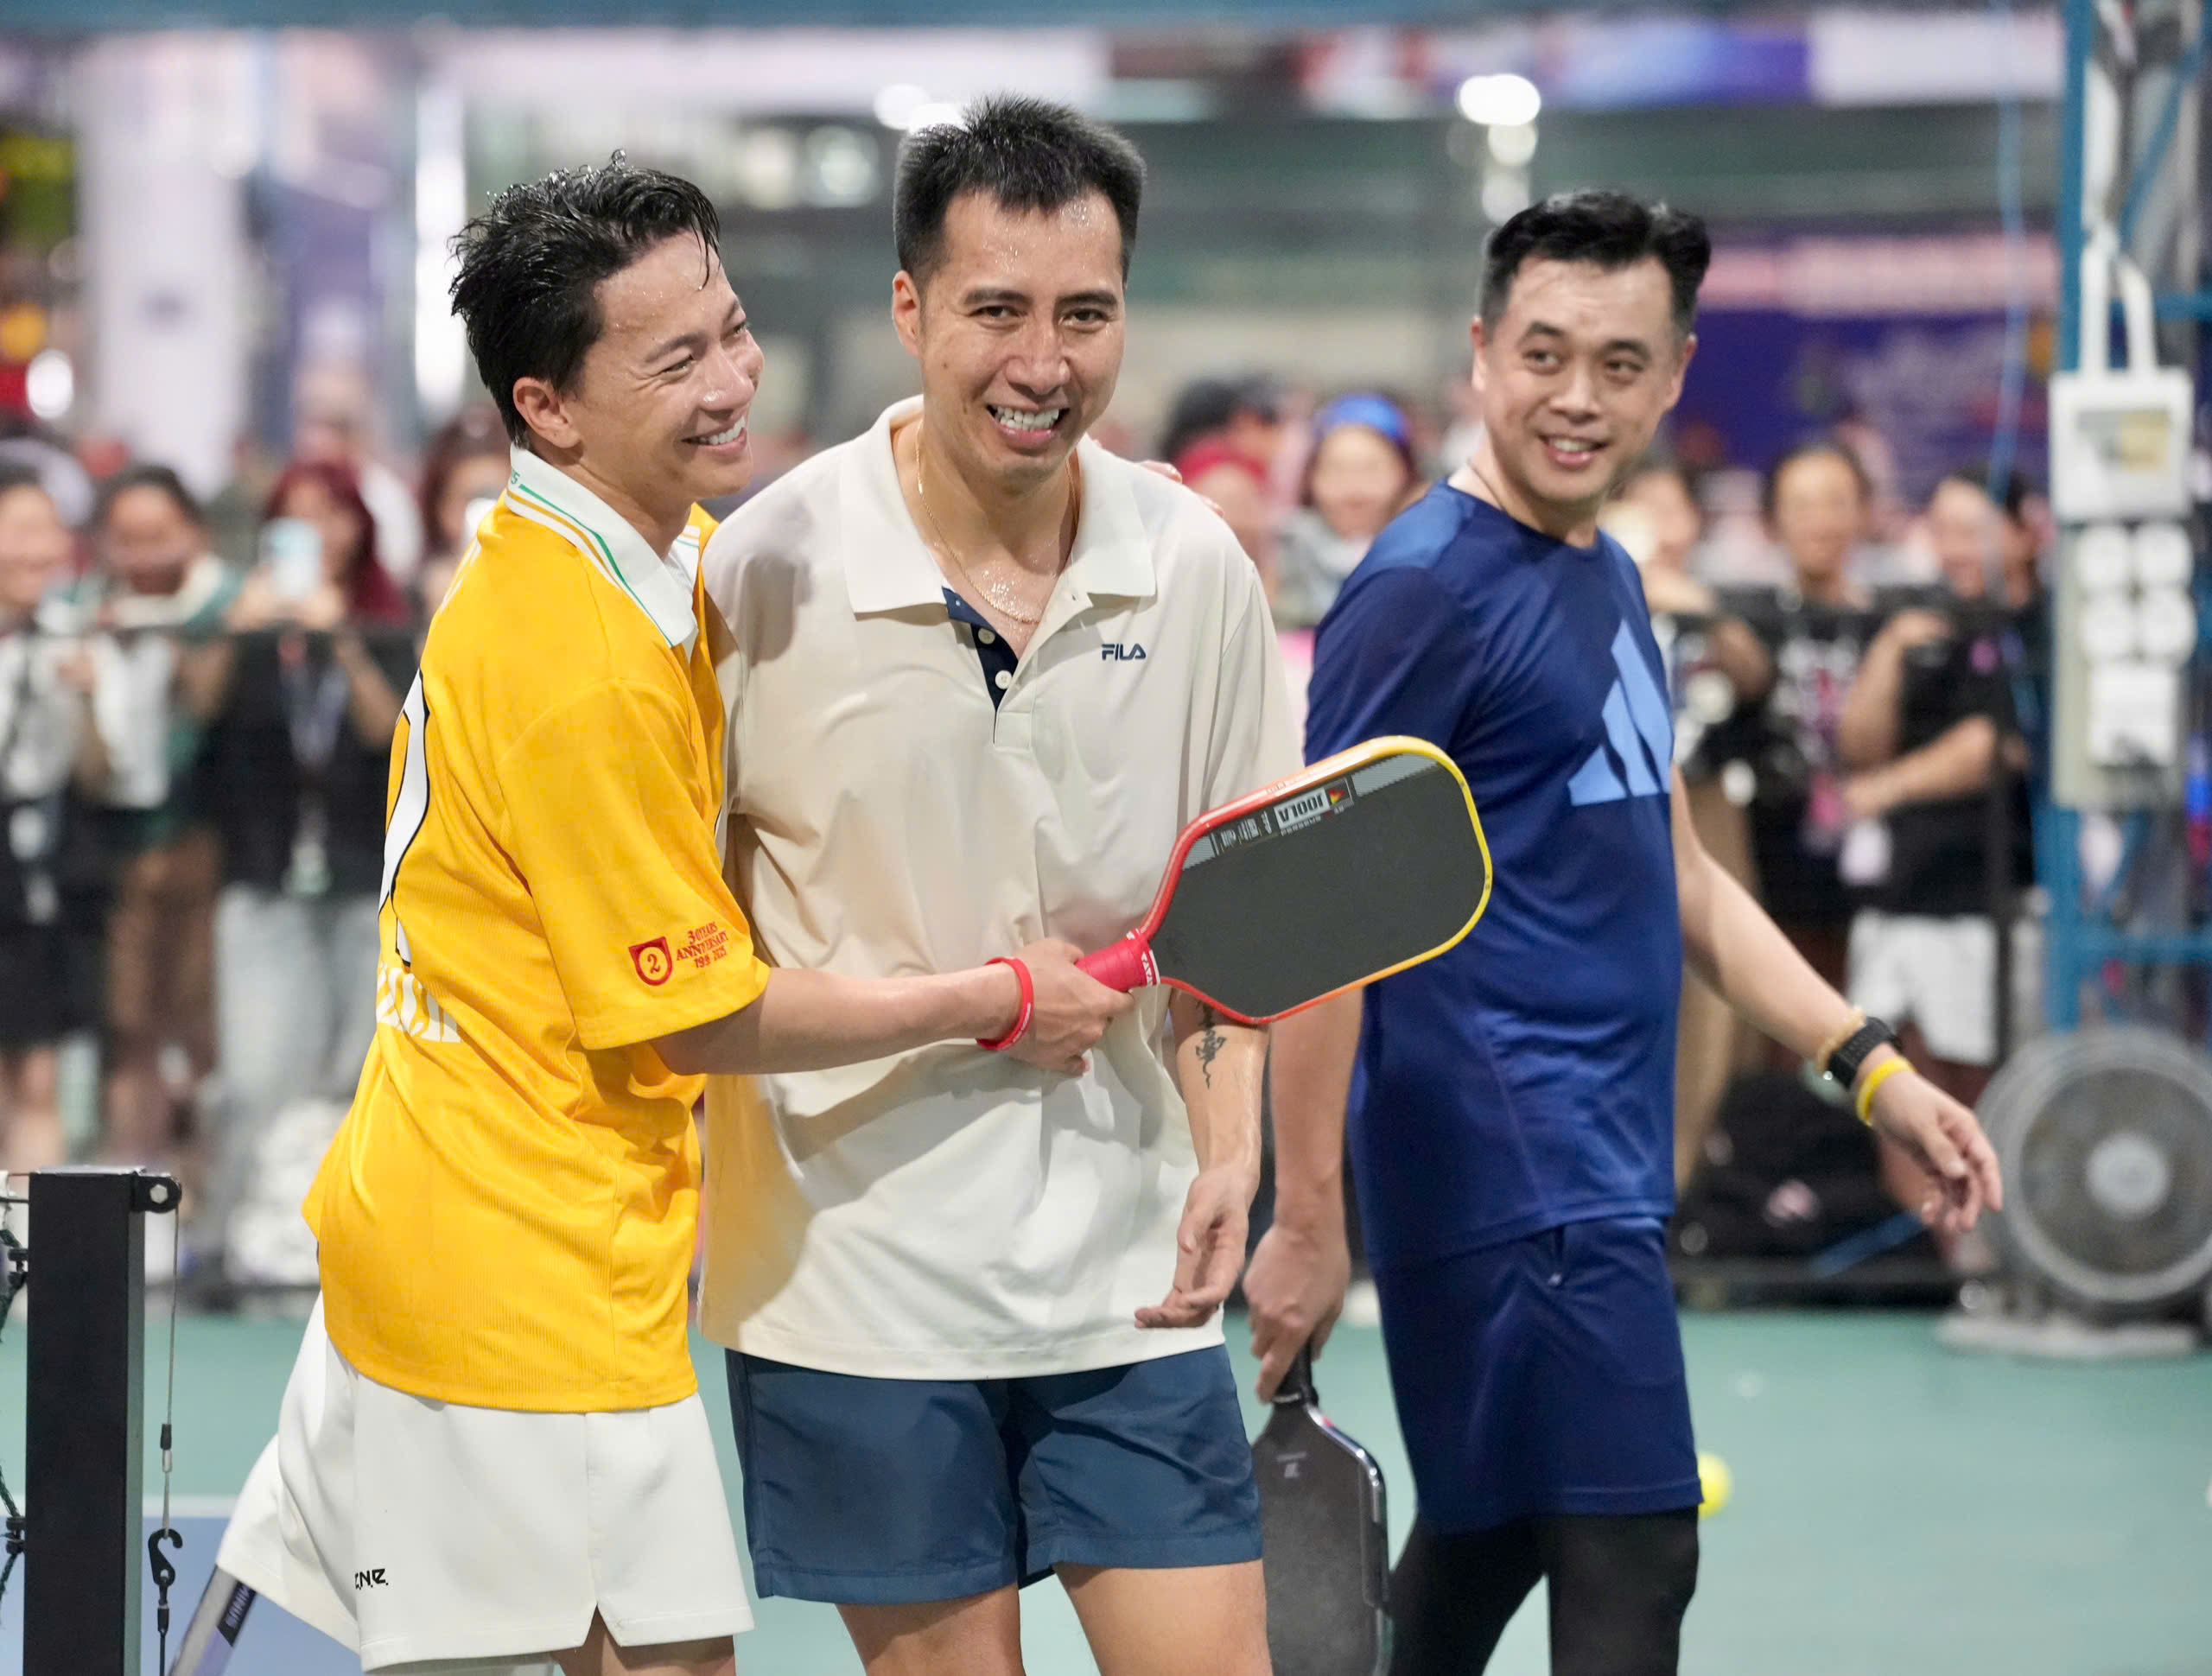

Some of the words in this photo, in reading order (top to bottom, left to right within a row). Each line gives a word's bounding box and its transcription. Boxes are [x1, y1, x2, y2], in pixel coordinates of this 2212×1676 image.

[1101, 643, 1147, 661] FILA
[1277, 794, 1325, 822] JOOLA
[646, 953, 661, 974] 2
